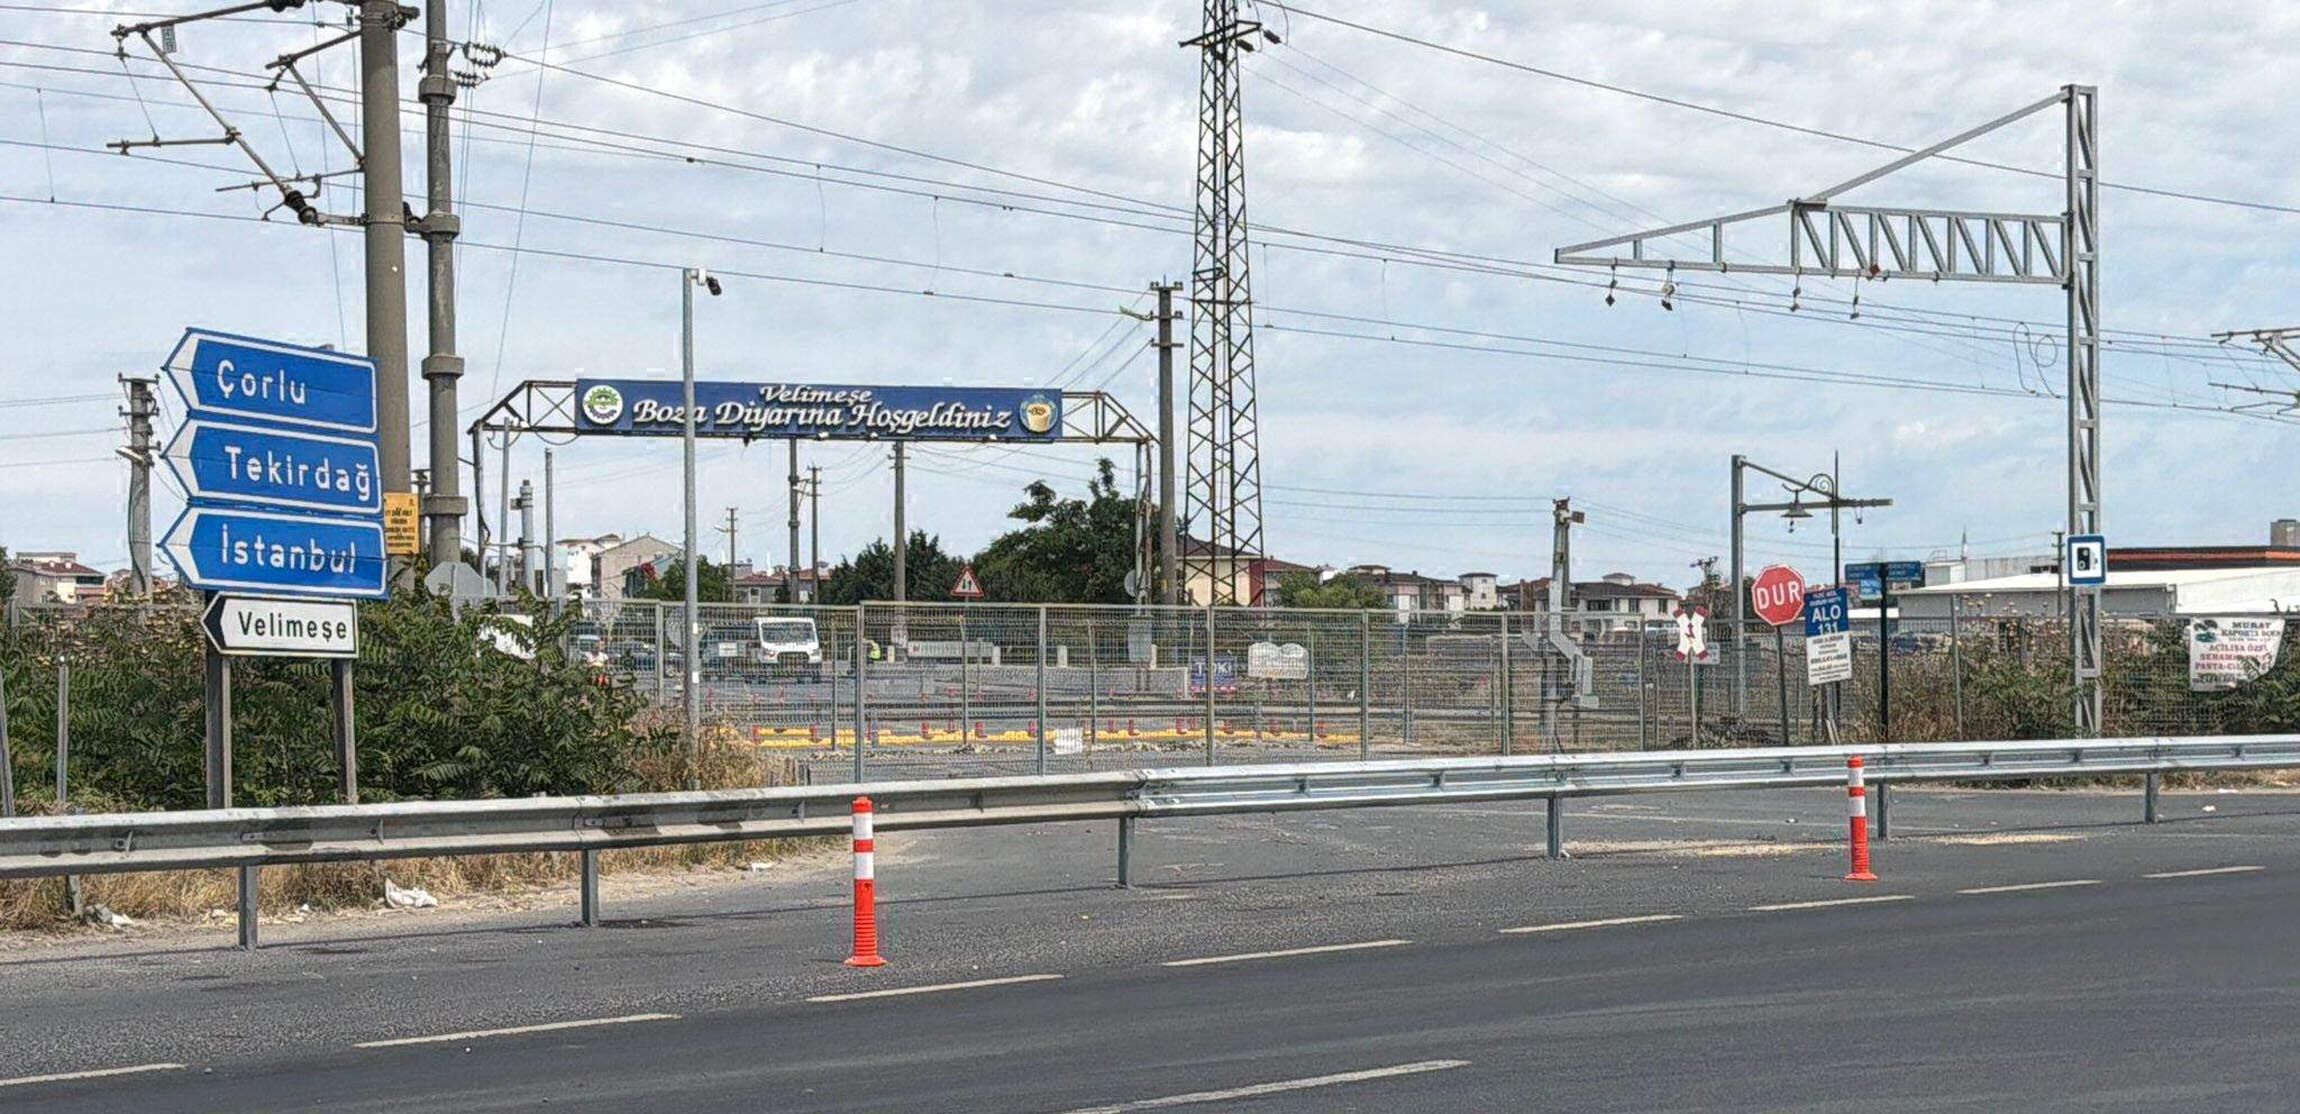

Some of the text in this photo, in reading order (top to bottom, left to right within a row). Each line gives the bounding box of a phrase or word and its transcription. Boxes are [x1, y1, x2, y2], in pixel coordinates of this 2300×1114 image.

[216, 359, 306, 405] Çorlu
[759, 384, 873, 406] Velimeşe
[633, 399, 707, 423] Boza
[714, 401, 844, 432] Diyarına
[850, 401, 1012, 433] Hoşgeldiniz
[224, 445, 371, 502] Tekirdağ
[220, 523, 357, 575] İstanbul
[1756, 580, 1802, 611] DUR
[237, 610, 348, 641] Velimeşe
[1811, 604, 1842, 624] ALO
[1817, 621, 1839, 637] 131
